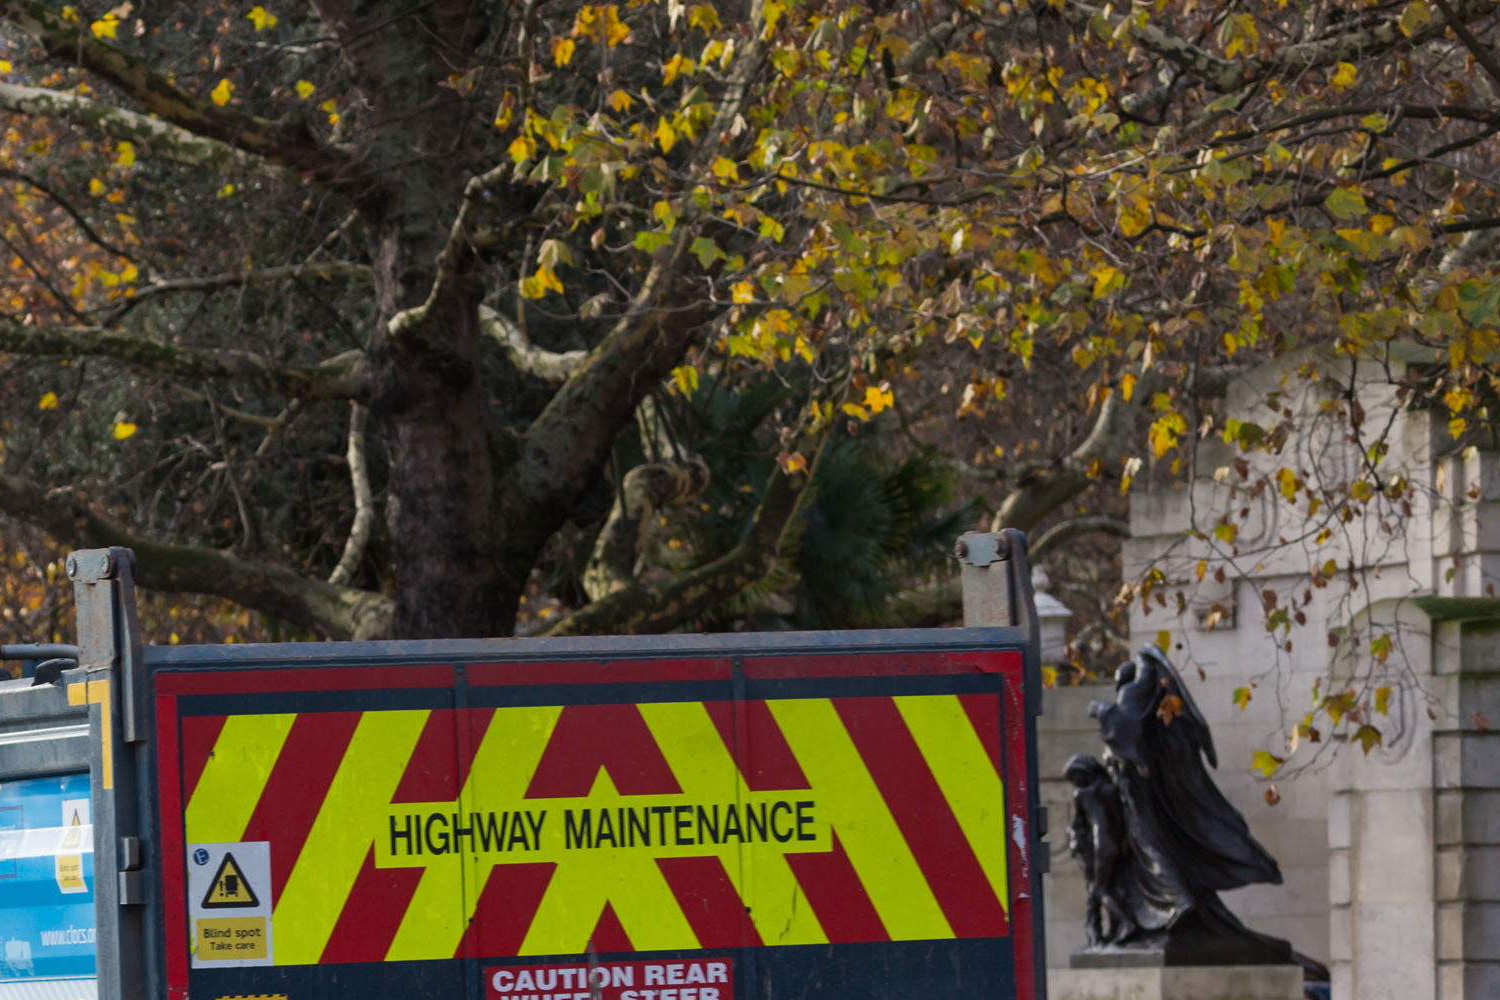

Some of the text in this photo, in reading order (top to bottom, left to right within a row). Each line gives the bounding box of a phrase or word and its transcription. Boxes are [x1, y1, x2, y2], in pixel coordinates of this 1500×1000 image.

[389, 801, 816, 856] HIGHWAY MAINTENANCE
[203, 927, 261, 939] Blind spot
[210, 942, 255, 950] Take care
[492, 962, 728, 993] CAUTION REAR
